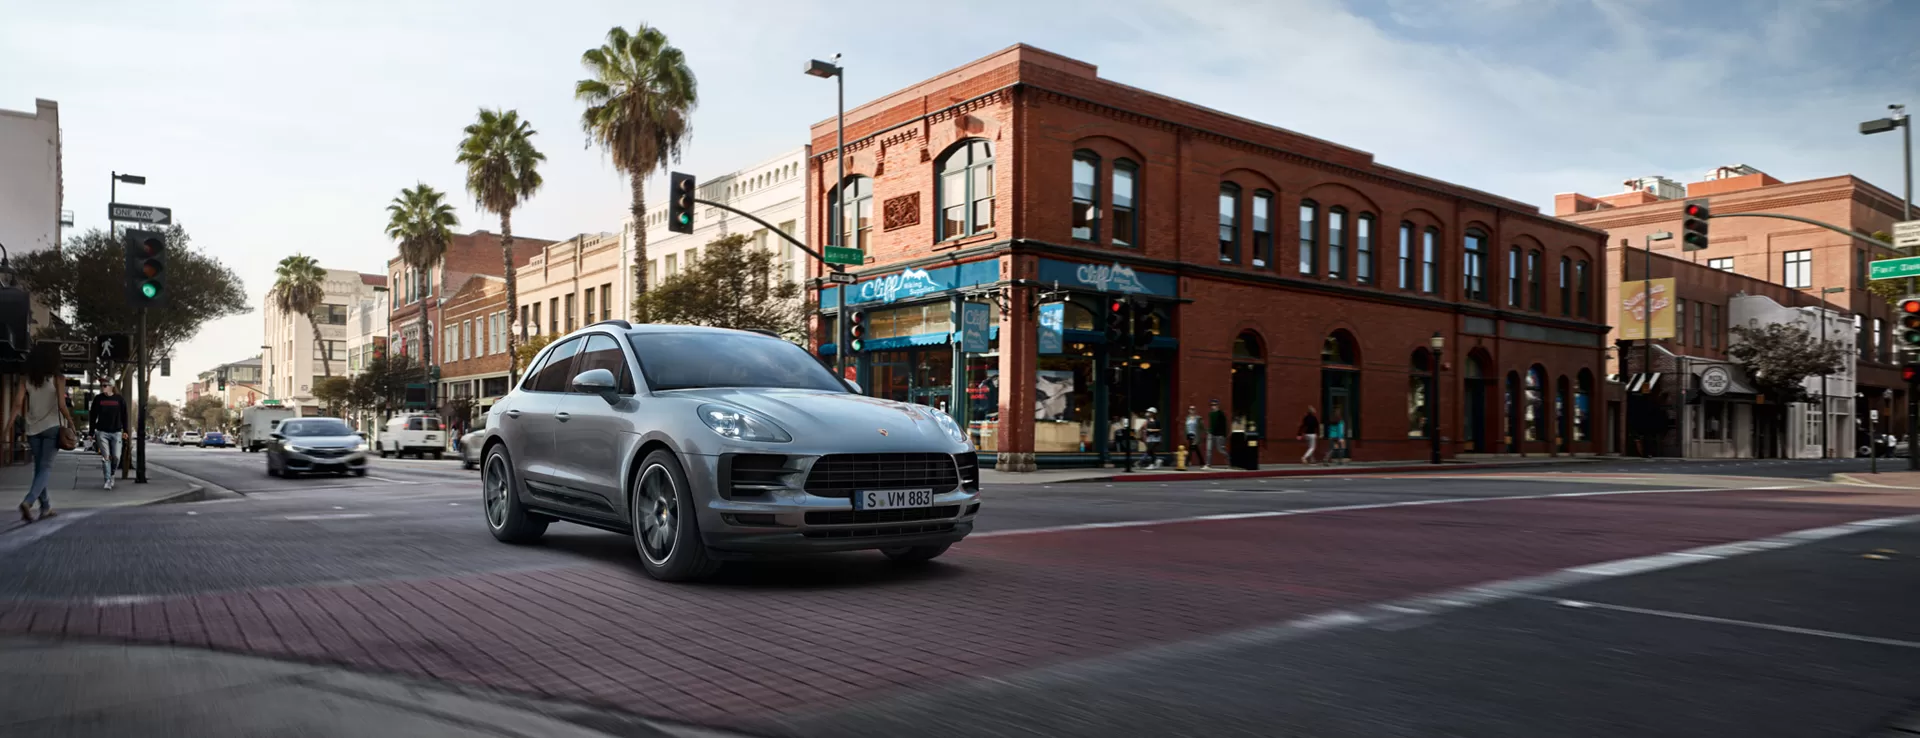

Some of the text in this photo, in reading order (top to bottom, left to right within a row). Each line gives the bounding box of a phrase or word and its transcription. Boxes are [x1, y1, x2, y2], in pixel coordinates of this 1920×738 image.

[115, 207, 152, 220] ONE WAY
[1076, 264, 1110, 292] Cliff
[1871, 265, 1897, 275] Fair
[861, 274, 900, 303] Cliff
[867, 490, 930, 508] S VM 883
